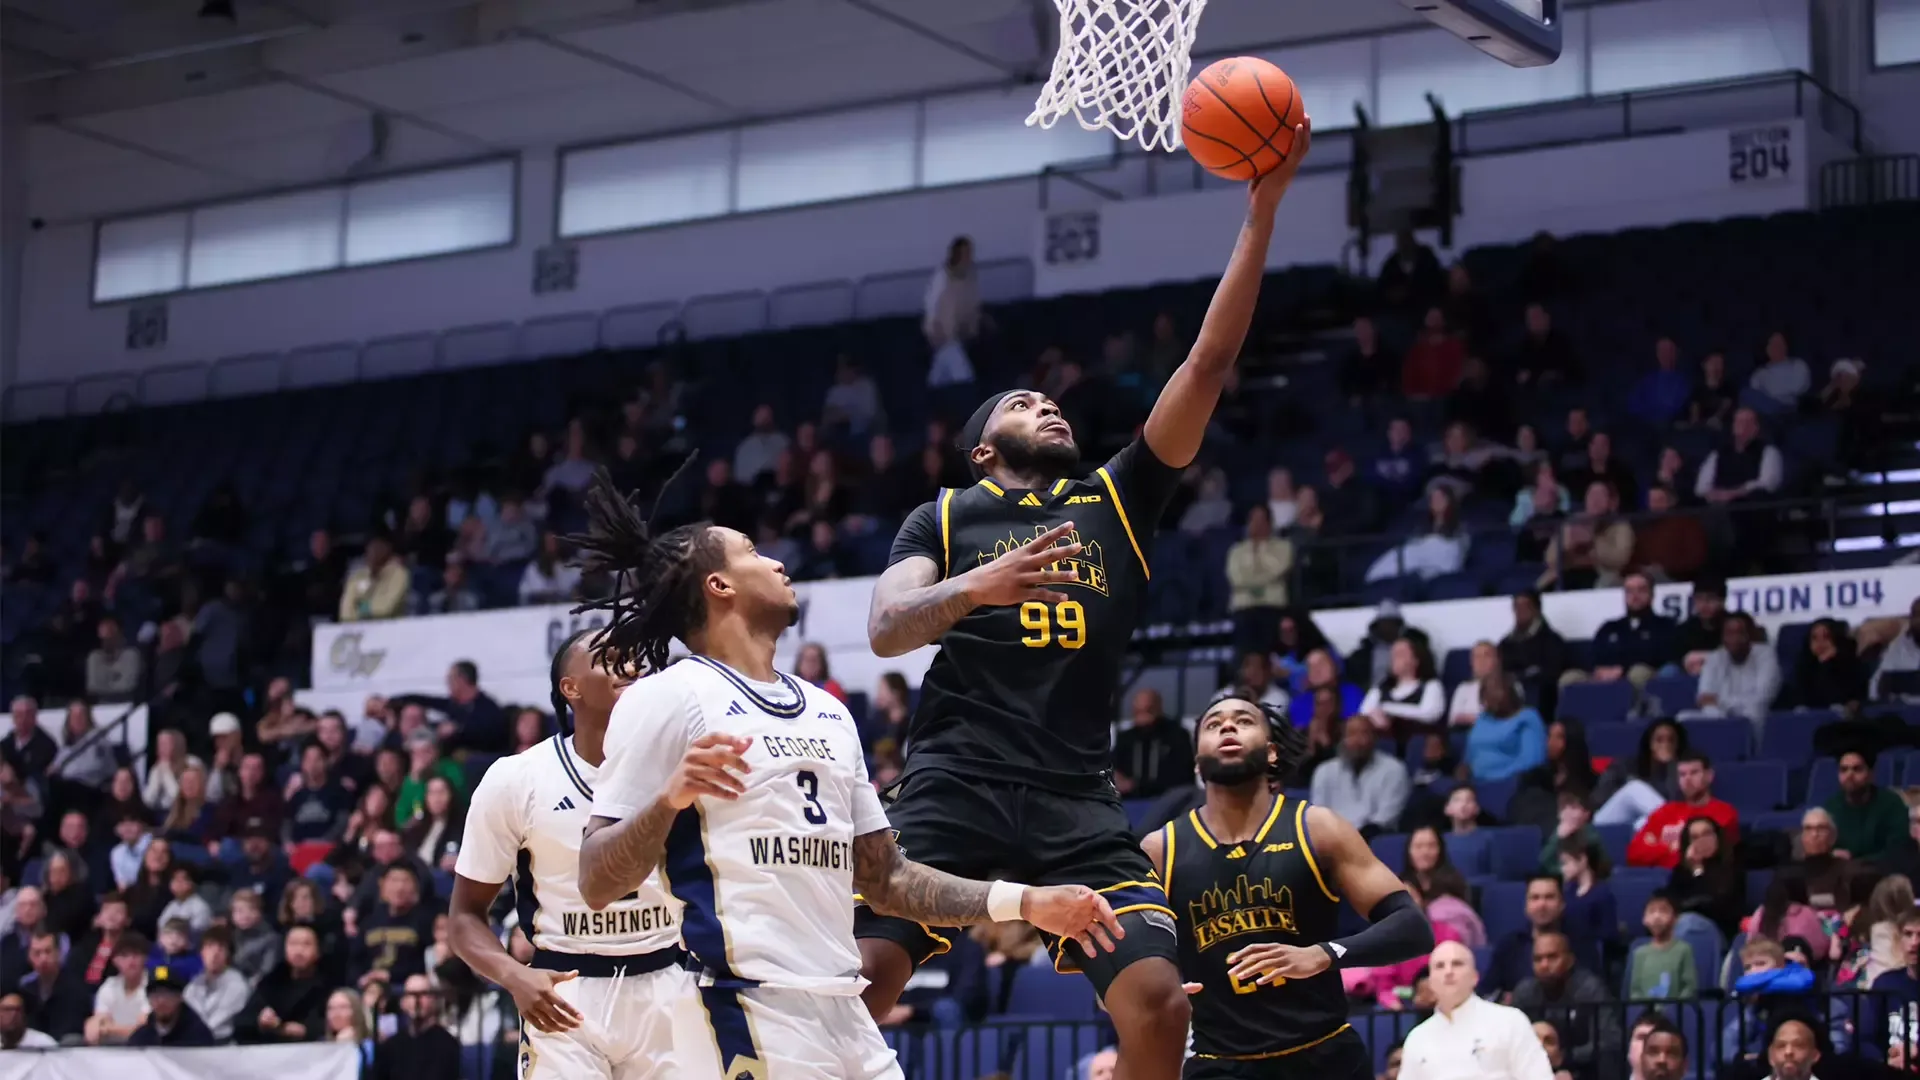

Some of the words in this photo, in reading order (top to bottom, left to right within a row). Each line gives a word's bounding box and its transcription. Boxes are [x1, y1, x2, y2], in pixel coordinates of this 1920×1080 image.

[1730, 145, 1789, 182] 204
[1064, 495, 1101, 505] A10
[1662, 584, 1811, 618] STION
[1826, 579, 1884, 608] 104
[1020, 601, 1086, 649] 99
[817, 712, 842, 721] A10
[763, 735, 836, 761] GEORGE
[797, 770, 827, 825] 3
[750, 836, 853, 871] WASHINGT
[563, 906, 675, 935] WASHINGTO
[1194, 908, 1297, 949] LASALLE
